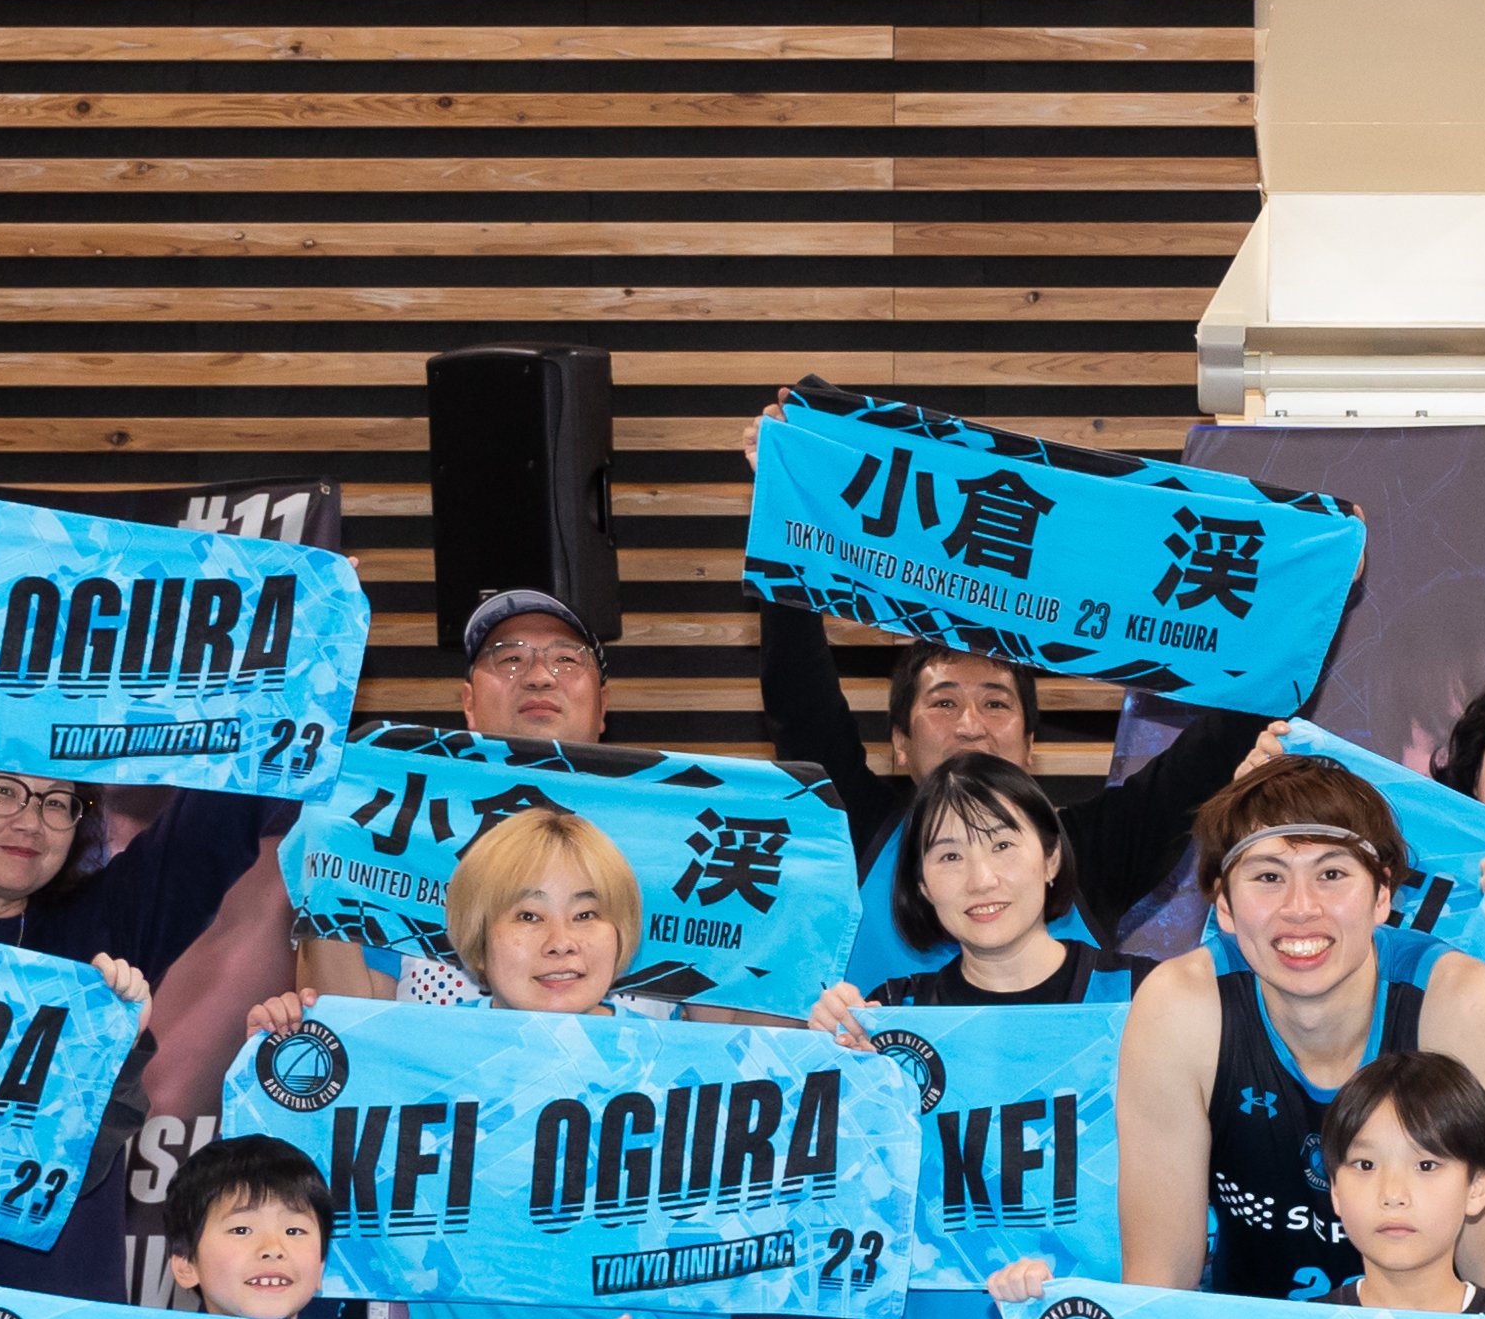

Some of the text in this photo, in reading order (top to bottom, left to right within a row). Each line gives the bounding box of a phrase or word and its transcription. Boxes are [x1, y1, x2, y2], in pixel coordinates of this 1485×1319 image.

[839, 445, 1265, 621] 小倉 渓
[785, 519, 1219, 654] TOKYO UNITED BASKETBALL CLUB 23 KEI OGURA
[54, 719, 239, 759] TOKYO UNITED BC
[259, 718, 324, 777] 23
[673, 806, 791, 915] 渓
[348, 856, 744, 950] UNITED KEI OGURA
[303, 1023, 340, 1052] UNITED
[263, 1079, 342, 1109] BASKETBALL CLUB
[528, 1067, 842, 1234] OGURA
[0, 1159, 69, 1223] 23
[595, 1231, 795, 1294] TOKYO UNITED BC
[819, 1228, 886, 1292] 23
